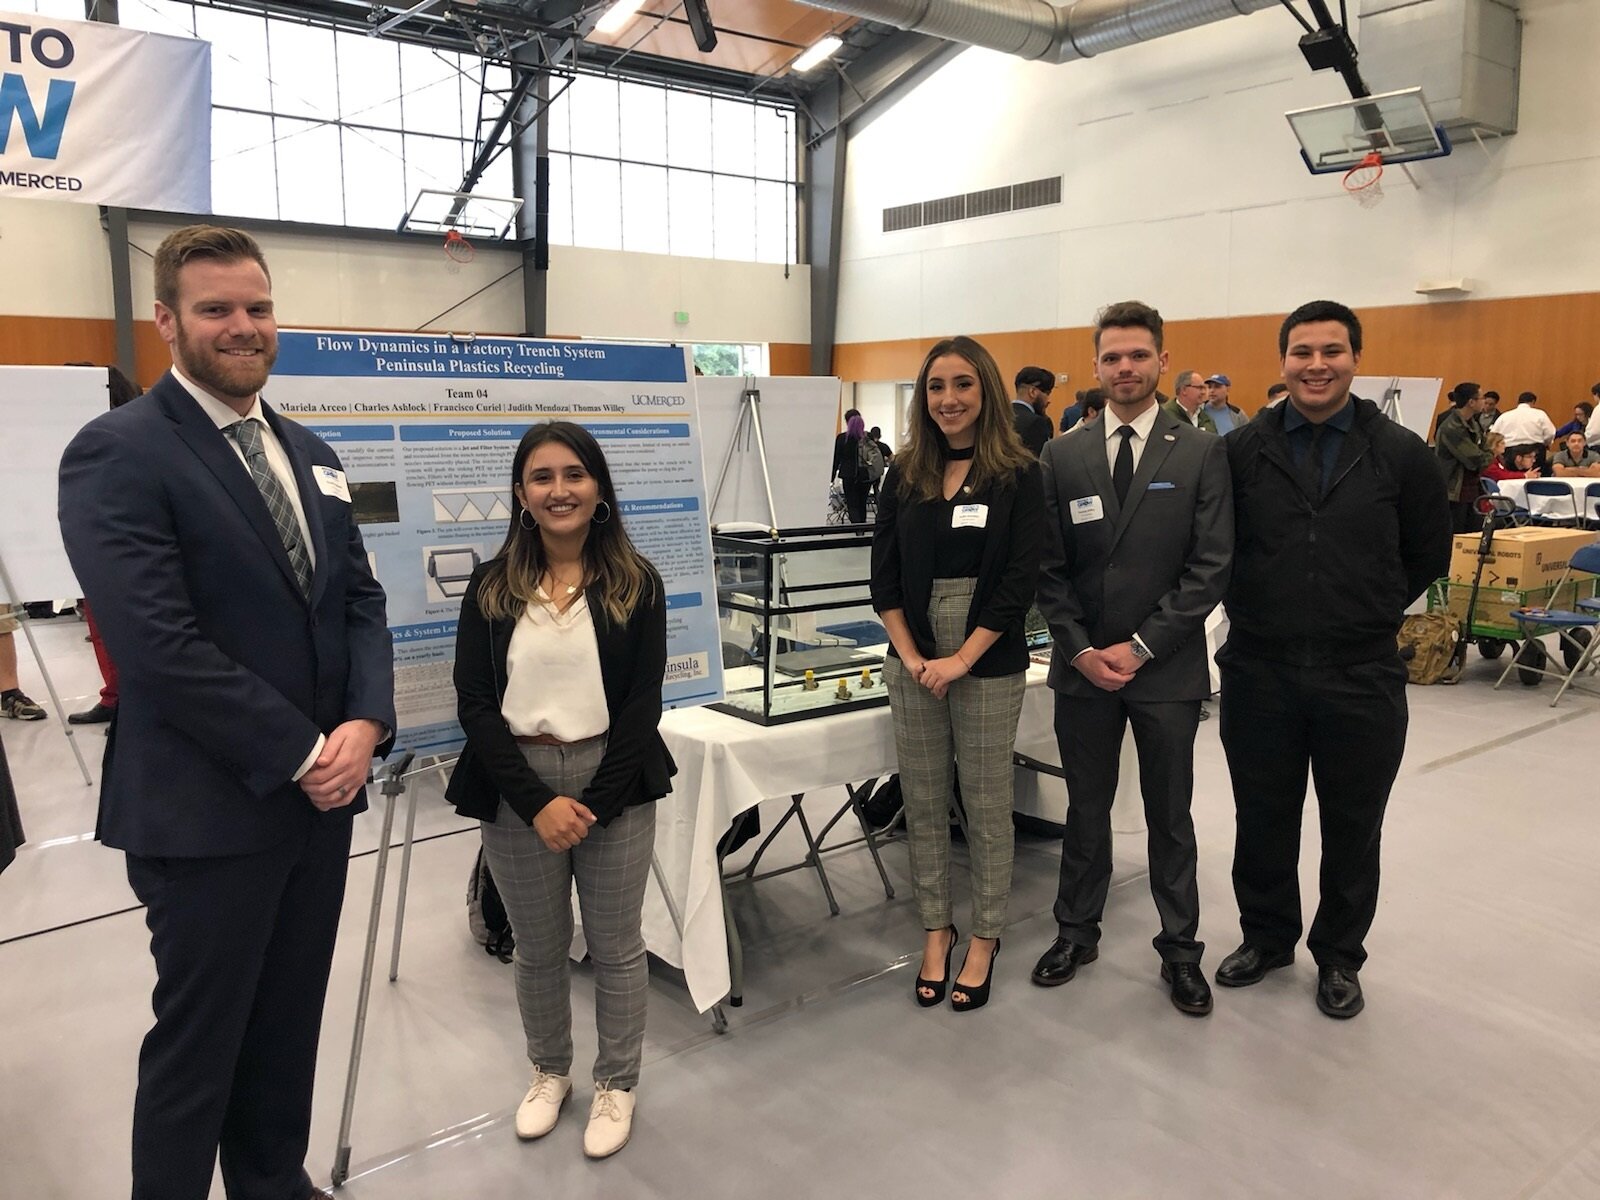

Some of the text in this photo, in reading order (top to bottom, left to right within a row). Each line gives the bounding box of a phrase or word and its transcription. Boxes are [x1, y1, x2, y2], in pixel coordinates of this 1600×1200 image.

[0, 22, 75, 69] TO
[0, 170, 83, 191] MERCED
[316, 336, 606, 360] Flow Dynamics in a Factory Trench System
[376, 357, 565, 377] Peninsula Plastics Recycling
[445, 388, 488, 399] Team 04
[279, 402, 317, 412] Mariela
[319, 403, 347, 412] Arceo
[354, 402, 391, 412] Charles
[392, 403, 426, 412] Ashlock
[433, 402, 473, 412] Francisco
[476, 402, 502, 412] Curiel
[507, 402, 533, 412] Judith
[573, 404, 601, 412] Thomas
[602, 404, 626, 414] Willey
[448, 429, 512, 439] Proposed Solution
[626, 427, 670, 435] Considerations
[631, 502, 684, 512] Recommendations
[1497, 551, 1522, 559] ROBOTS
[413, 626, 442, 638] System
[666, 656, 700, 673] insula
